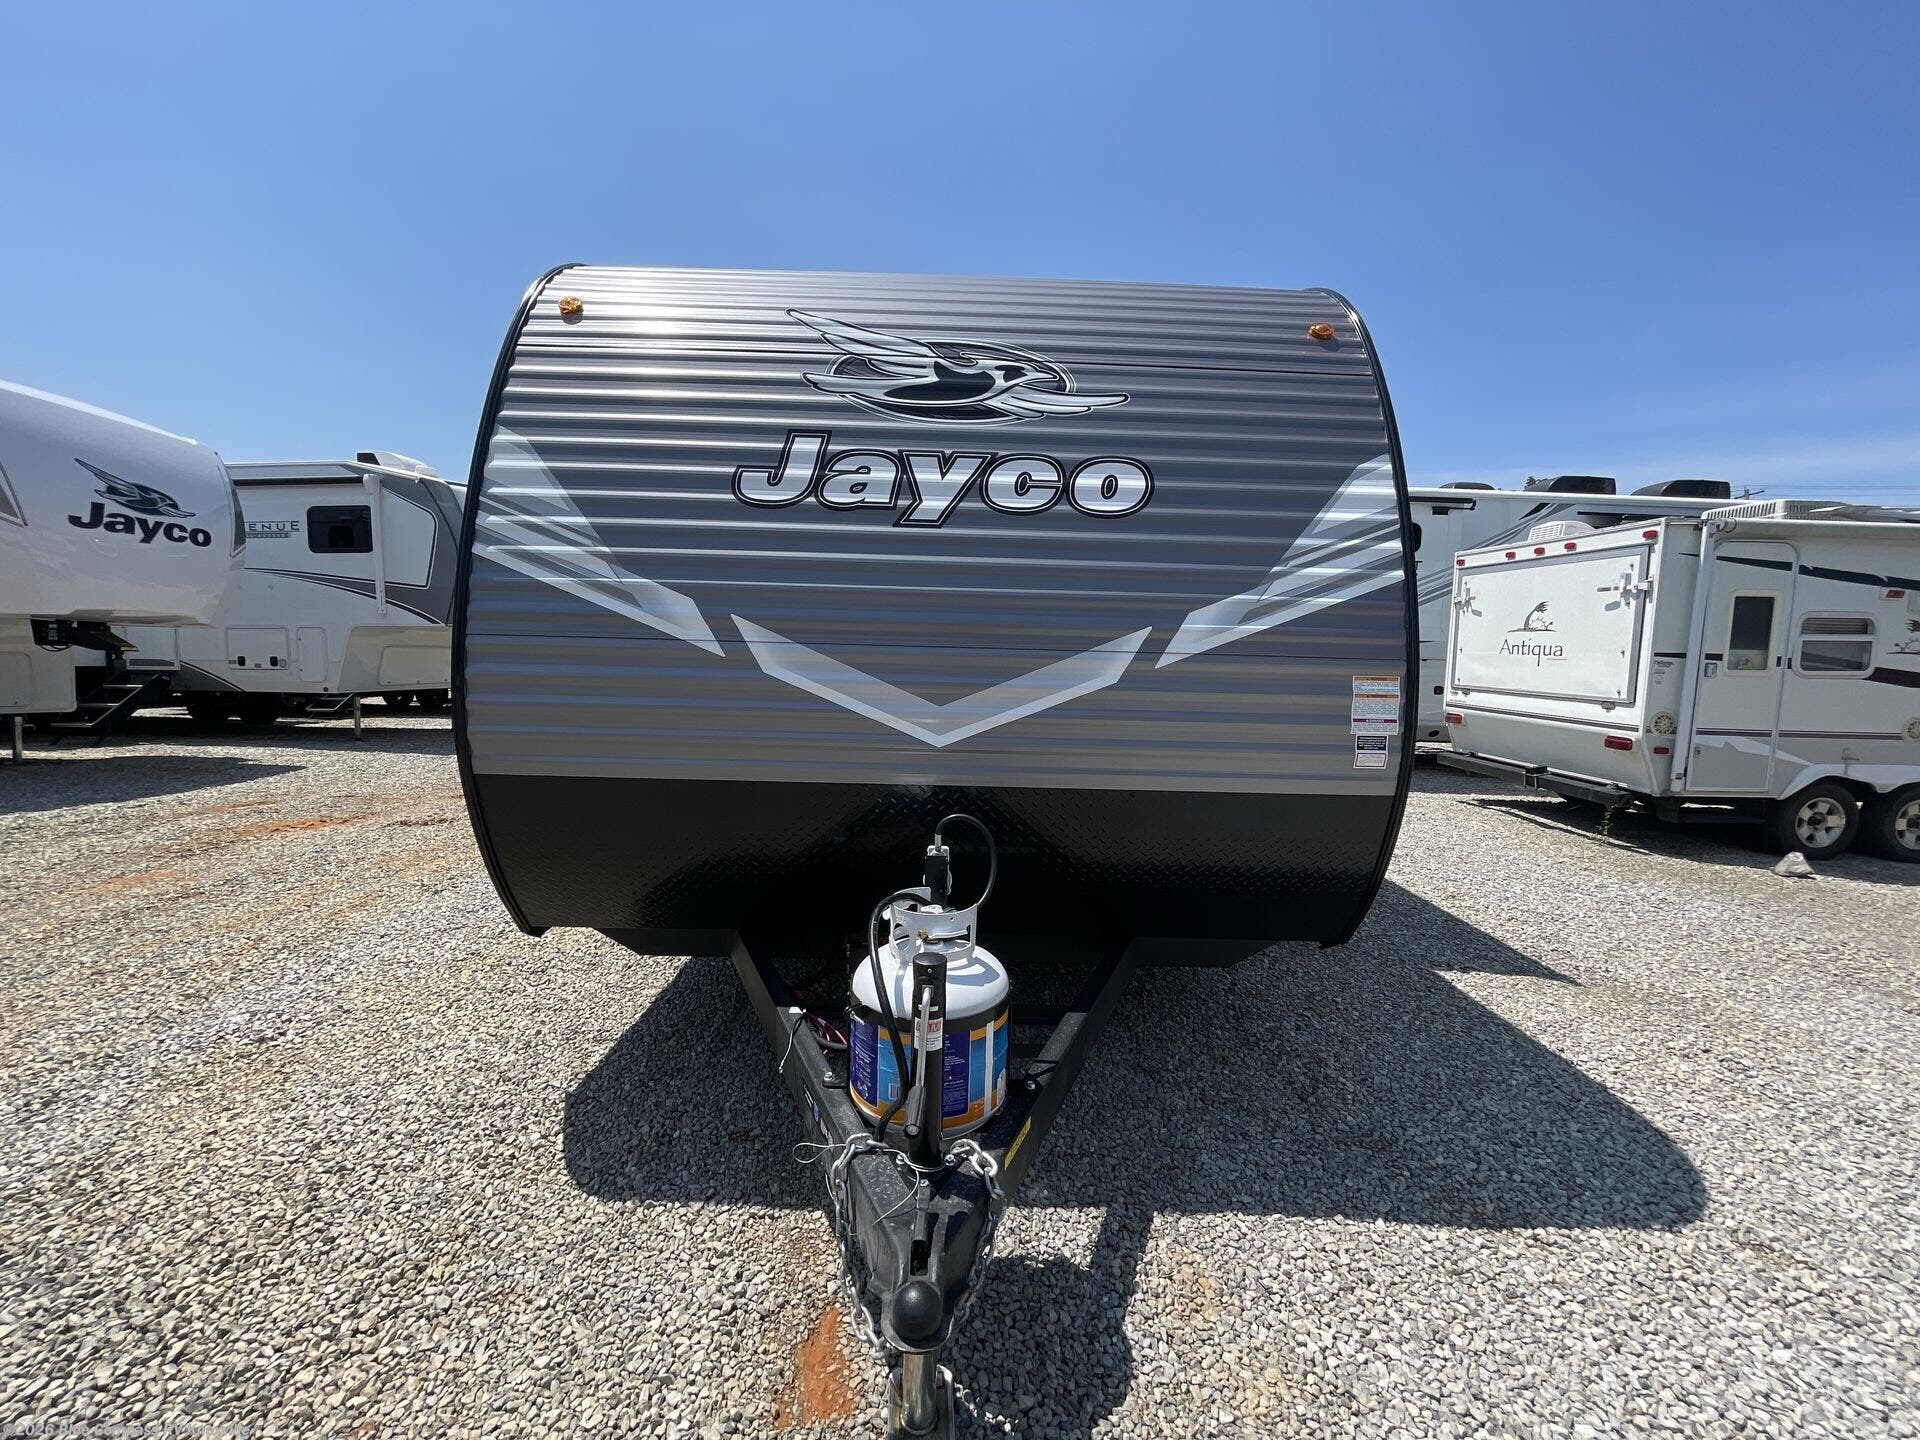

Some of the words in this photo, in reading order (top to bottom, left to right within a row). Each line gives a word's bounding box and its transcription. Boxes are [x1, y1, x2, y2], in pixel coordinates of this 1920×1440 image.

[731, 430, 1155, 527] Jayco
[68, 501, 212, 547] Jayco
[248, 521, 300, 531] ENUE
[1499, 638, 1563, 667] Antiqua
